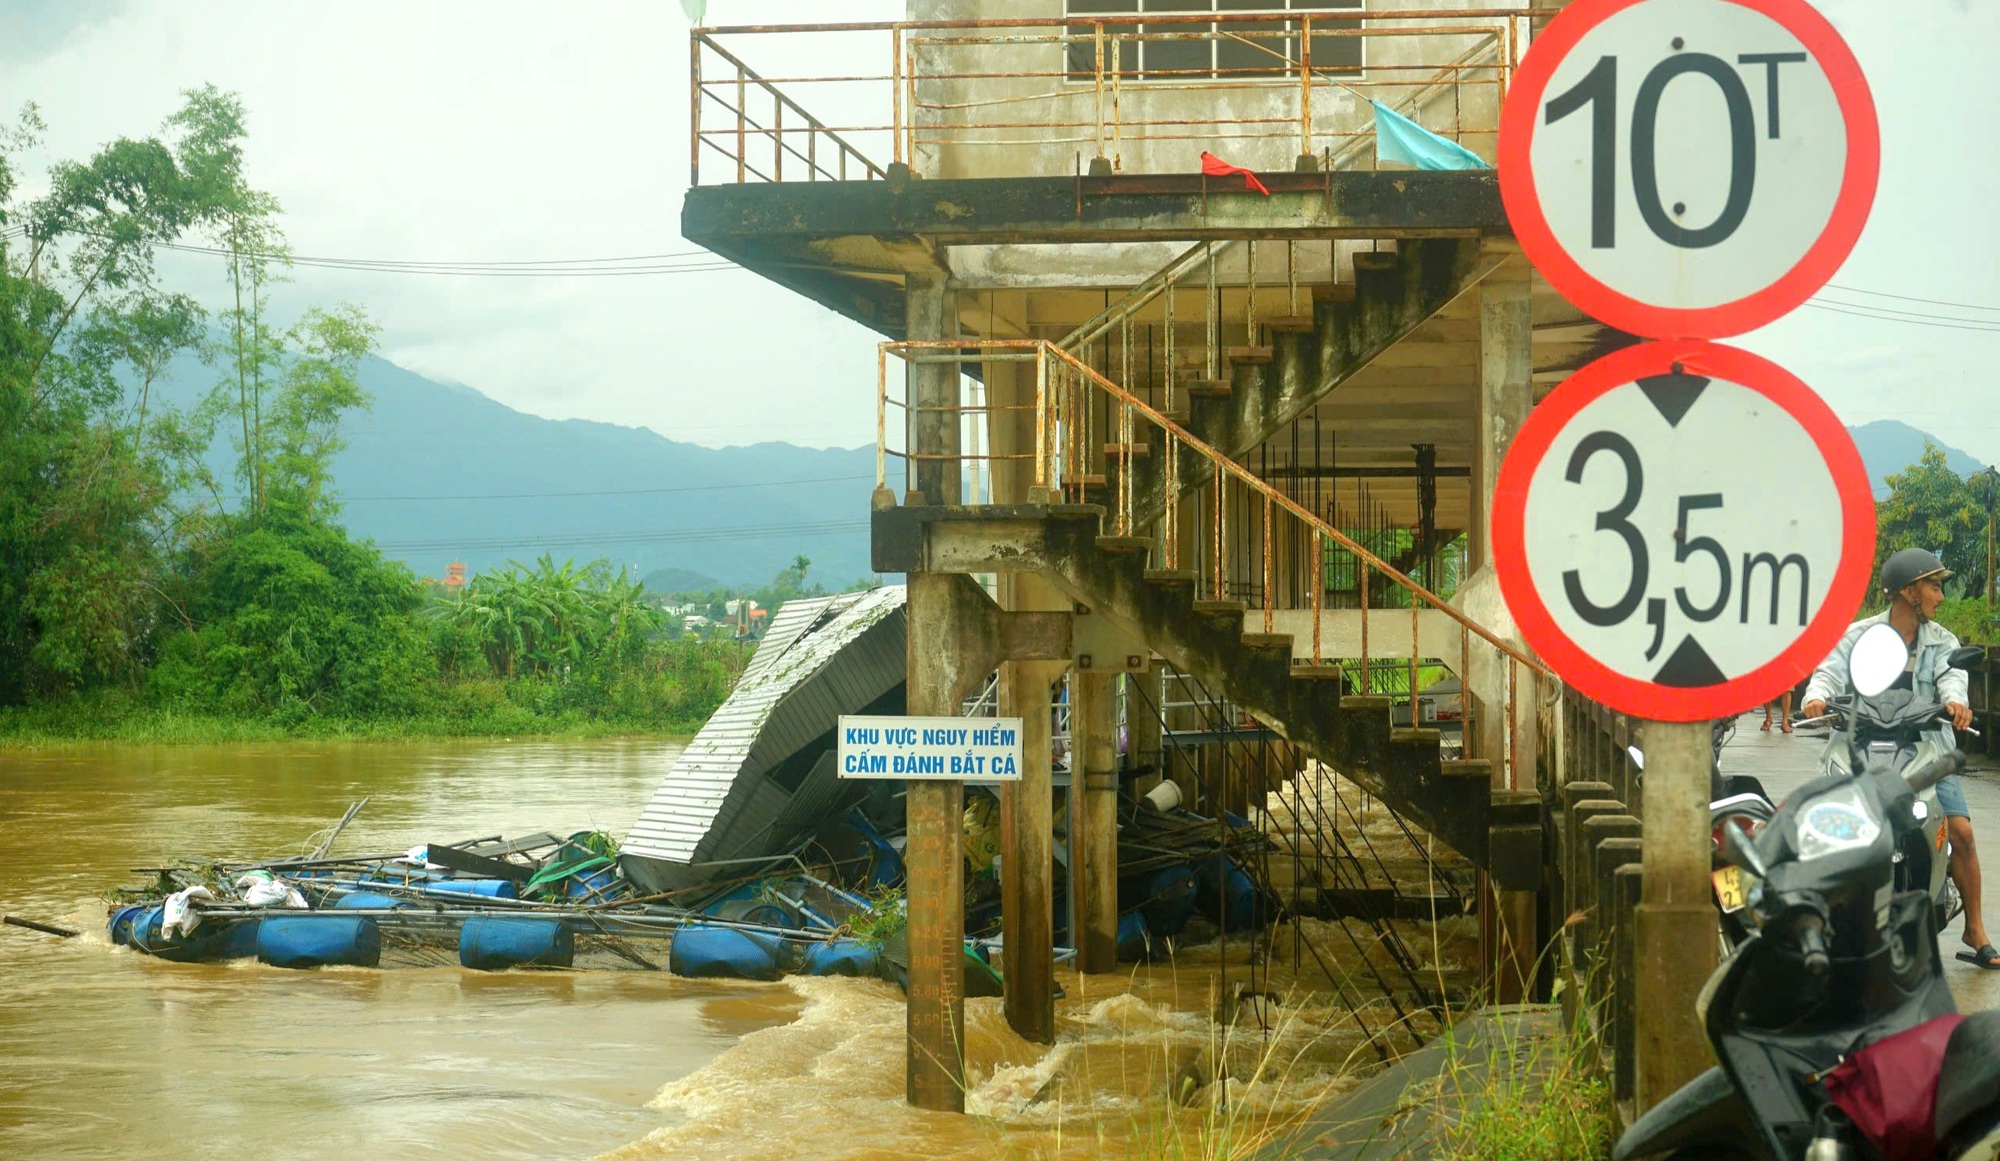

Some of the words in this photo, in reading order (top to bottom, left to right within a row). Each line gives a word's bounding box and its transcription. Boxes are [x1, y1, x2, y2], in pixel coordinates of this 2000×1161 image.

[846, 728, 879, 744] KHU
[885, 727, 917, 748] VỰC
[923, 729, 968, 746] NGUY
[973, 723, 1015, 746] HIỂM
[845, 749, 887, 773] CẤM
[893, 752, 944, 773] ĐÁNH
[950, 750, 986, 774] BẮT
[991, 752, 1016, 775] CÁ
